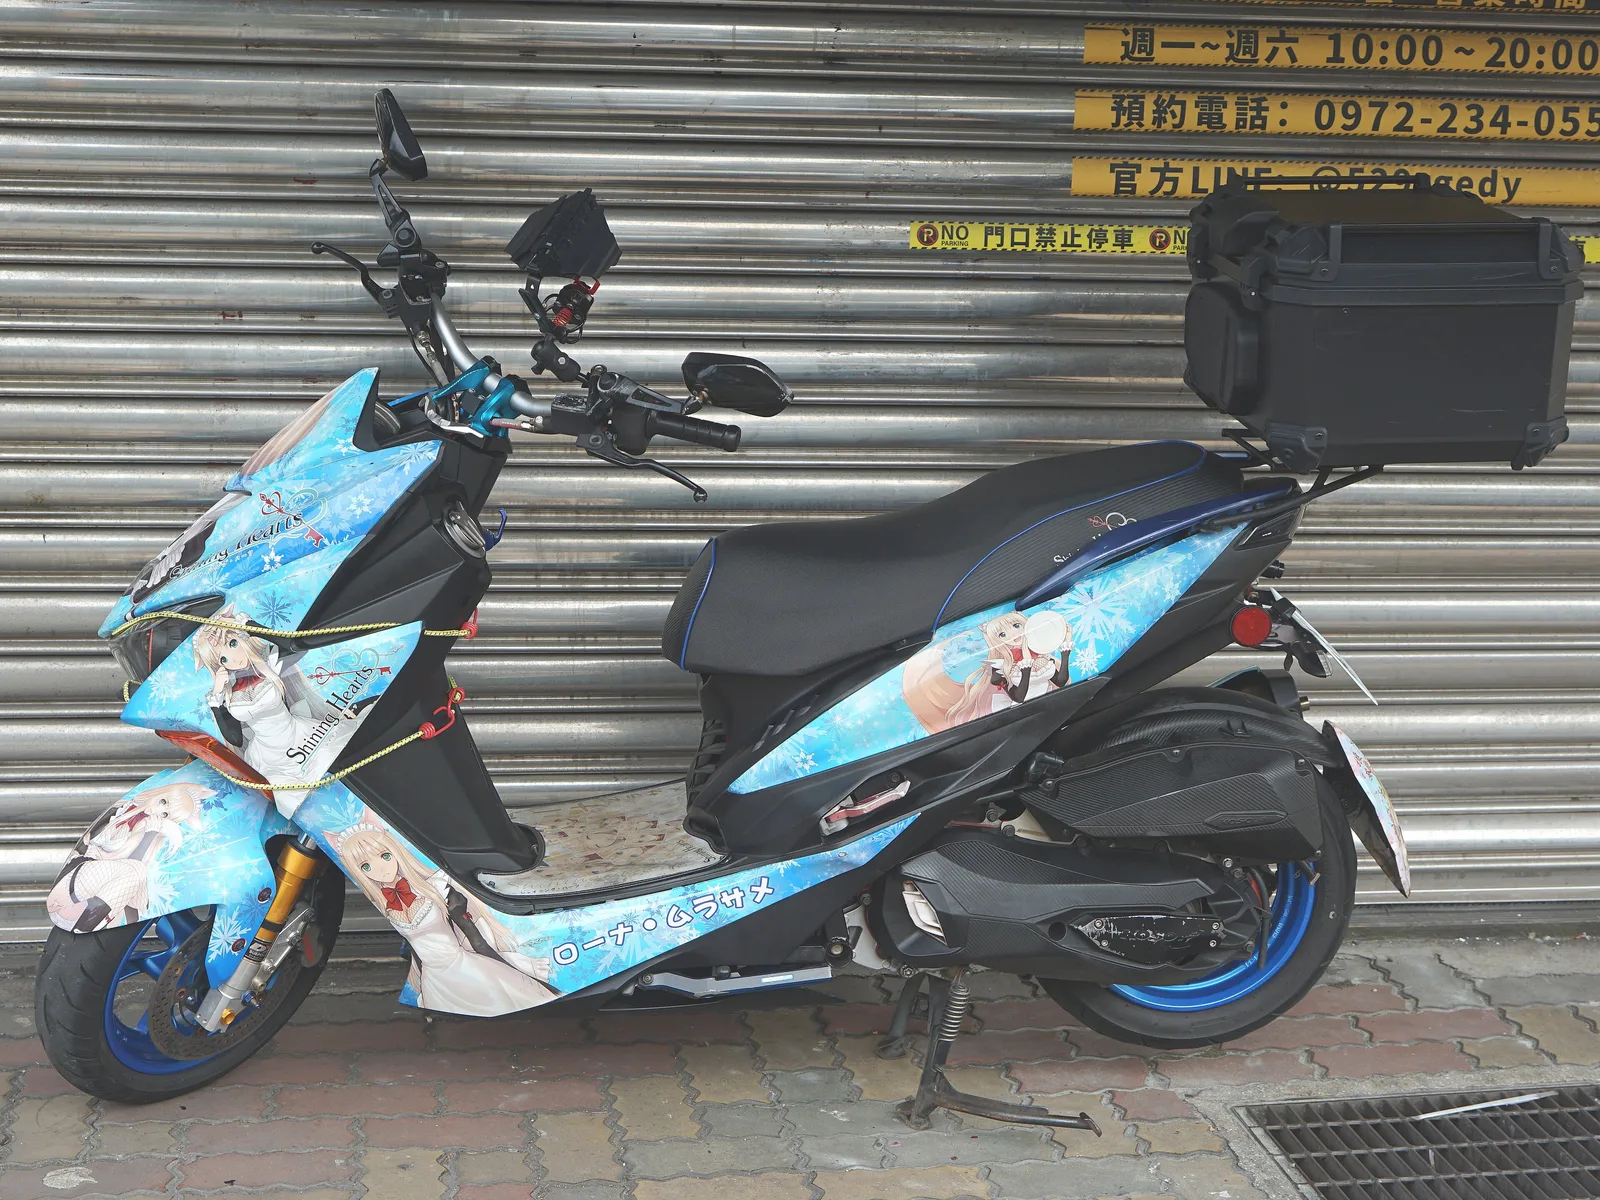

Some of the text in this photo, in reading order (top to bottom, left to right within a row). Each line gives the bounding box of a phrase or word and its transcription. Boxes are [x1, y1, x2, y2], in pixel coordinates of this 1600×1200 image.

[1325, 32, 1443, 66] 10:00
[1485, 36, 1599, 71] 20:00
[1313, 100, 1600, 137] 0972-234-055
[1110, 161, 1284, 196] 官方LIN
[941, 224, 969, 240] NO
[983, 225, 1135, 250] 門口禁止停車
[1173, 229, 1187, 245] N
[286, 664, 374, 765] Shining Hearts
